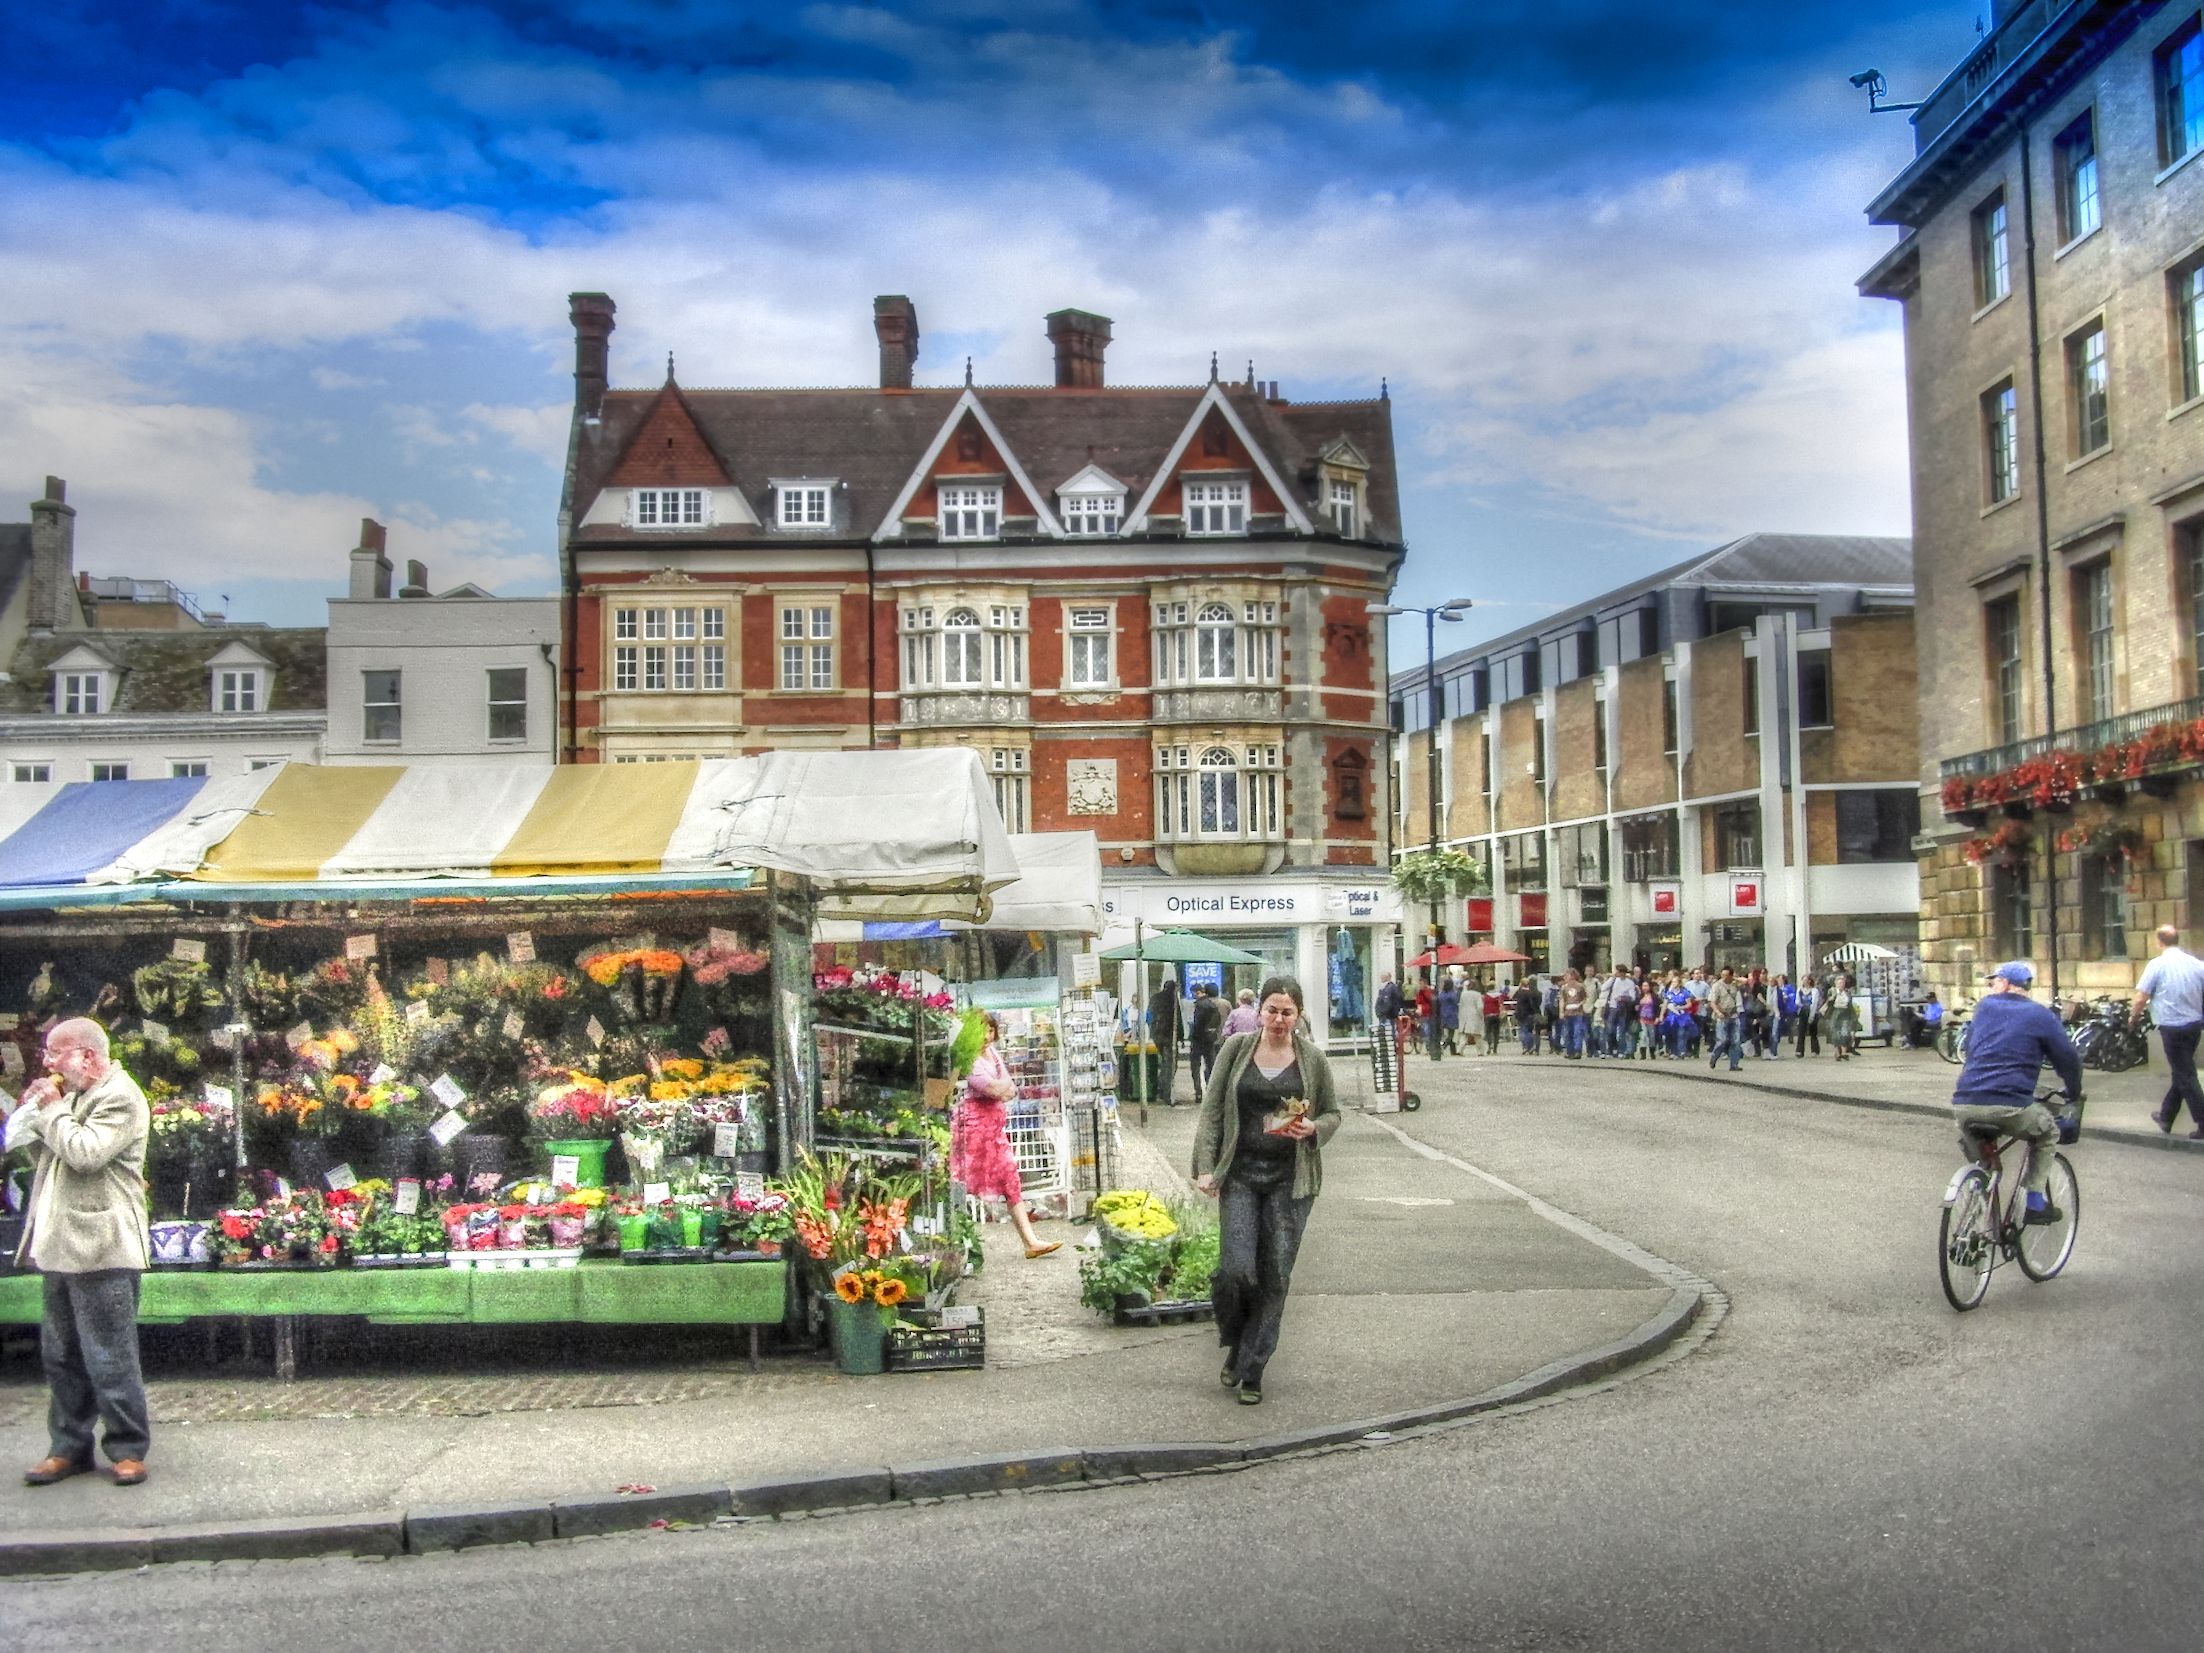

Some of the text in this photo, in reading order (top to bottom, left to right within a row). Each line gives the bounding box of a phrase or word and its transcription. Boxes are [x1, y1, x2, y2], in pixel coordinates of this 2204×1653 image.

[1343, 890, 1371, 904] ptical
[1167, 896, 1295, 914] Optical Express
[1349, 905, 1372, 916] Laser
[1188, 966, 1218, 978] SAVE
